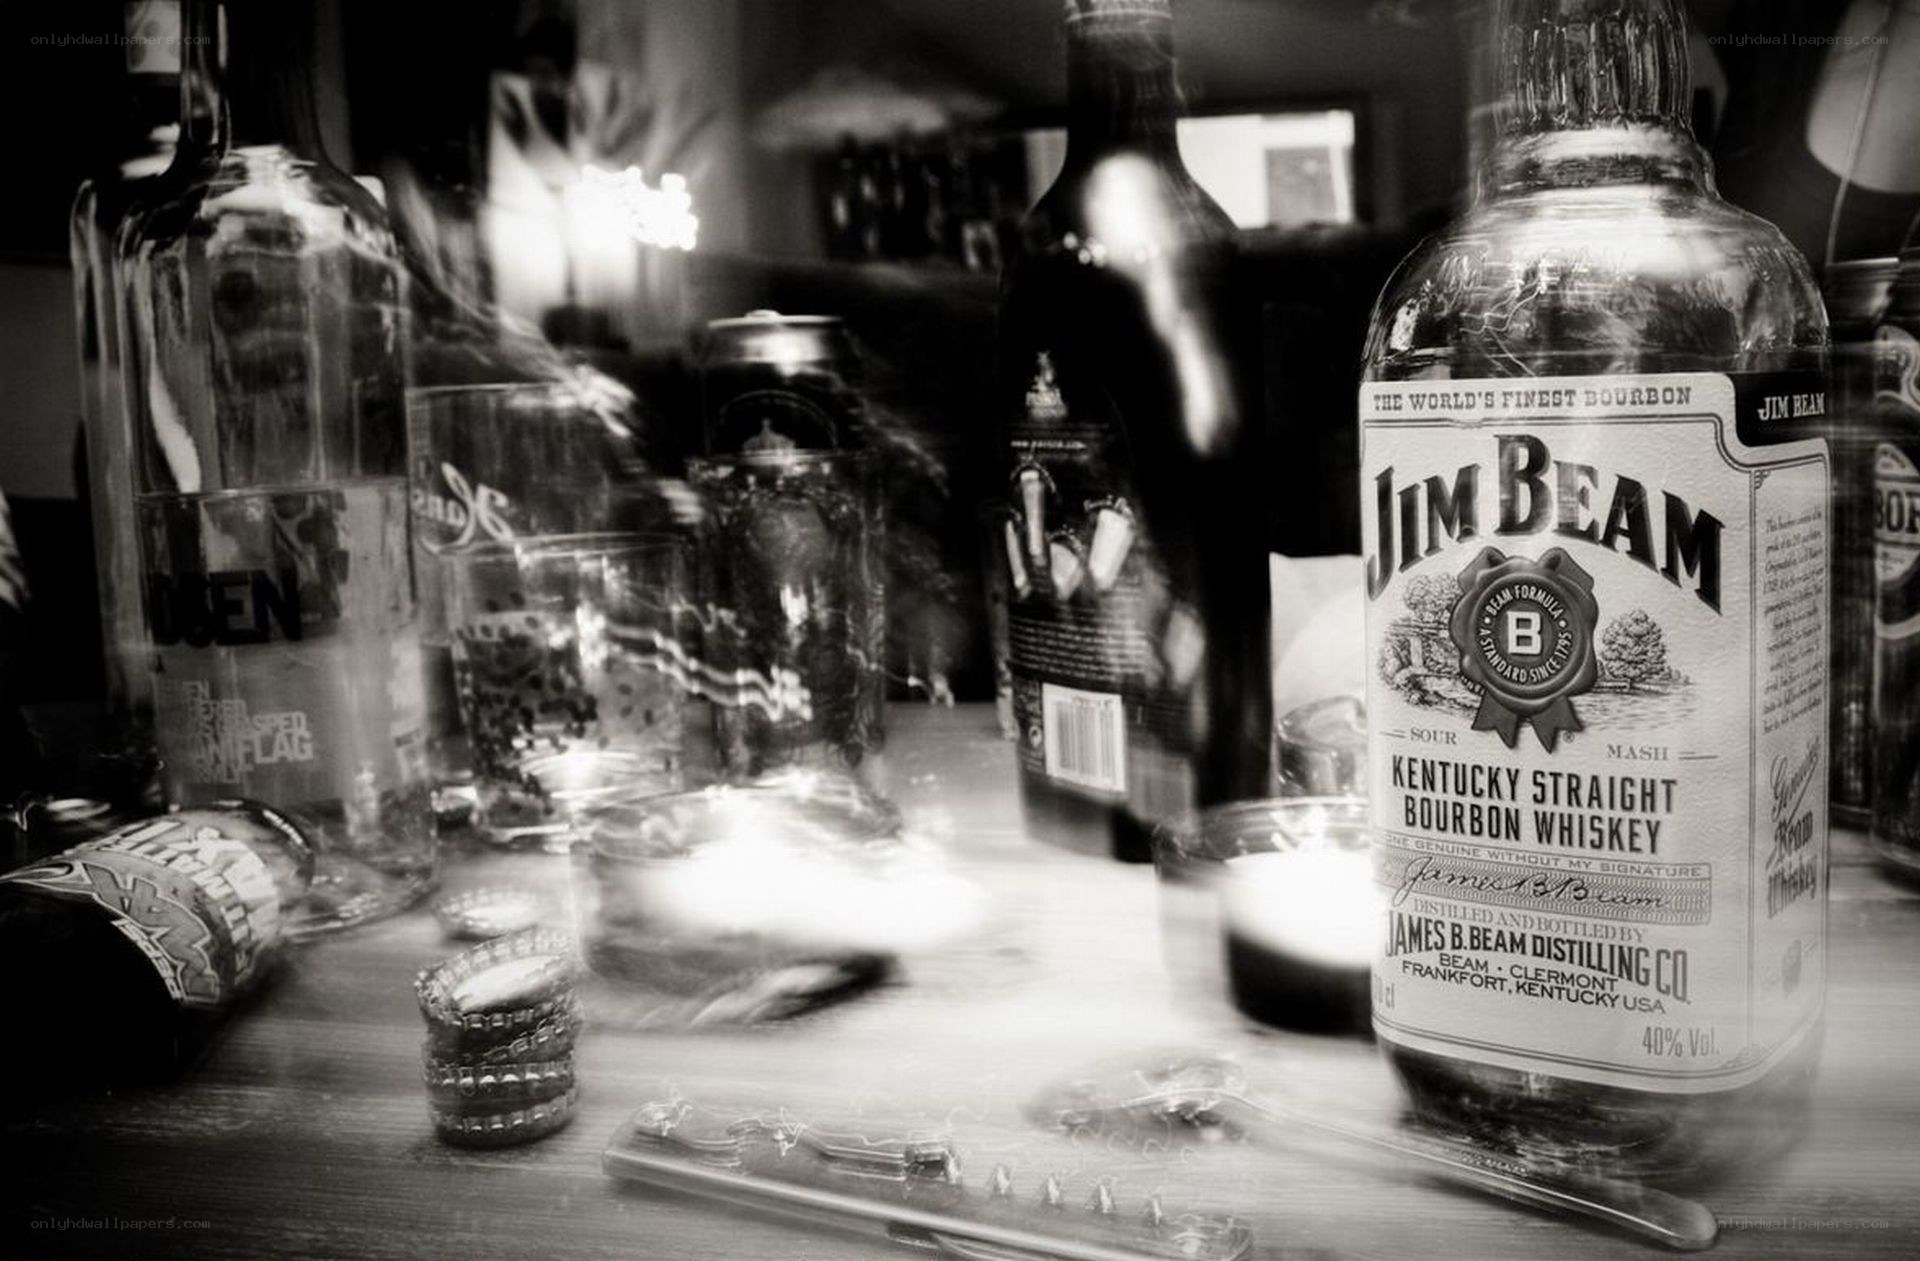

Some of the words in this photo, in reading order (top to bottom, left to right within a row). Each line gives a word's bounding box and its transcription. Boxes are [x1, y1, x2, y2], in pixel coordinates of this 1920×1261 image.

[1373, 393, 1401, 411] THE
[1409, 391, 1494, 411] WORLD'S
[1501, 389, 1577, 409] FINEST
[1584, 386, 1692, 408] BOURBON
[1757, 395, 1789, 421] JIM
[1792, 392, 1825, 418] BEAM
[1367, 462, 1483, 602] JIM
[1493, 433, 1727, 616] BEAM
[1485, 588, 1514, 616] BEAM
[1514, 584, 1564, 620] FORMULA
[1506, 610, 1542, 656] B
[1480, 637, 1527, 683] STANDARD
[1529, 656, 1561, 682] SINCE
[1409, 727, 1458, 746] SOUR
[1606, 743, 1670, 762] MASH
[1392, 753, 1521, 803] KENTUCKY
[1532, 769, 1679, 815] STRAIGHT
[1404, 794, 1521, 842] BOURBON
[1534, 809, 1662, 855] WHISKEY
[1415, 841, 1481, 858] GENUINE
[1487, 849, 1561, 867] WITHOUT
[1568, 859, 1592, 870] MY
[1600, 862, 1701, 878] SIGNATURE
[1413, 898, 1494, 924] DISTILLED
[1496, 911, 1535, 931] AND
[1537, 917, 1617, 940] BOTTLED
[1620, 926, 1648, 943] BY
[1386, 910, 1446, 957] JAMES
[1531, 934, 1651, 987] DISTILLING
[1439, 952, 1490, 974] BEAM
[1509, 964, 1620, 993] CLERMONT
[1515, 981, 1621, 1009] KENTUCKY
[1622, 995, 1667, 1014] USA
[1642, 1025, 1683, 1058] 40%
